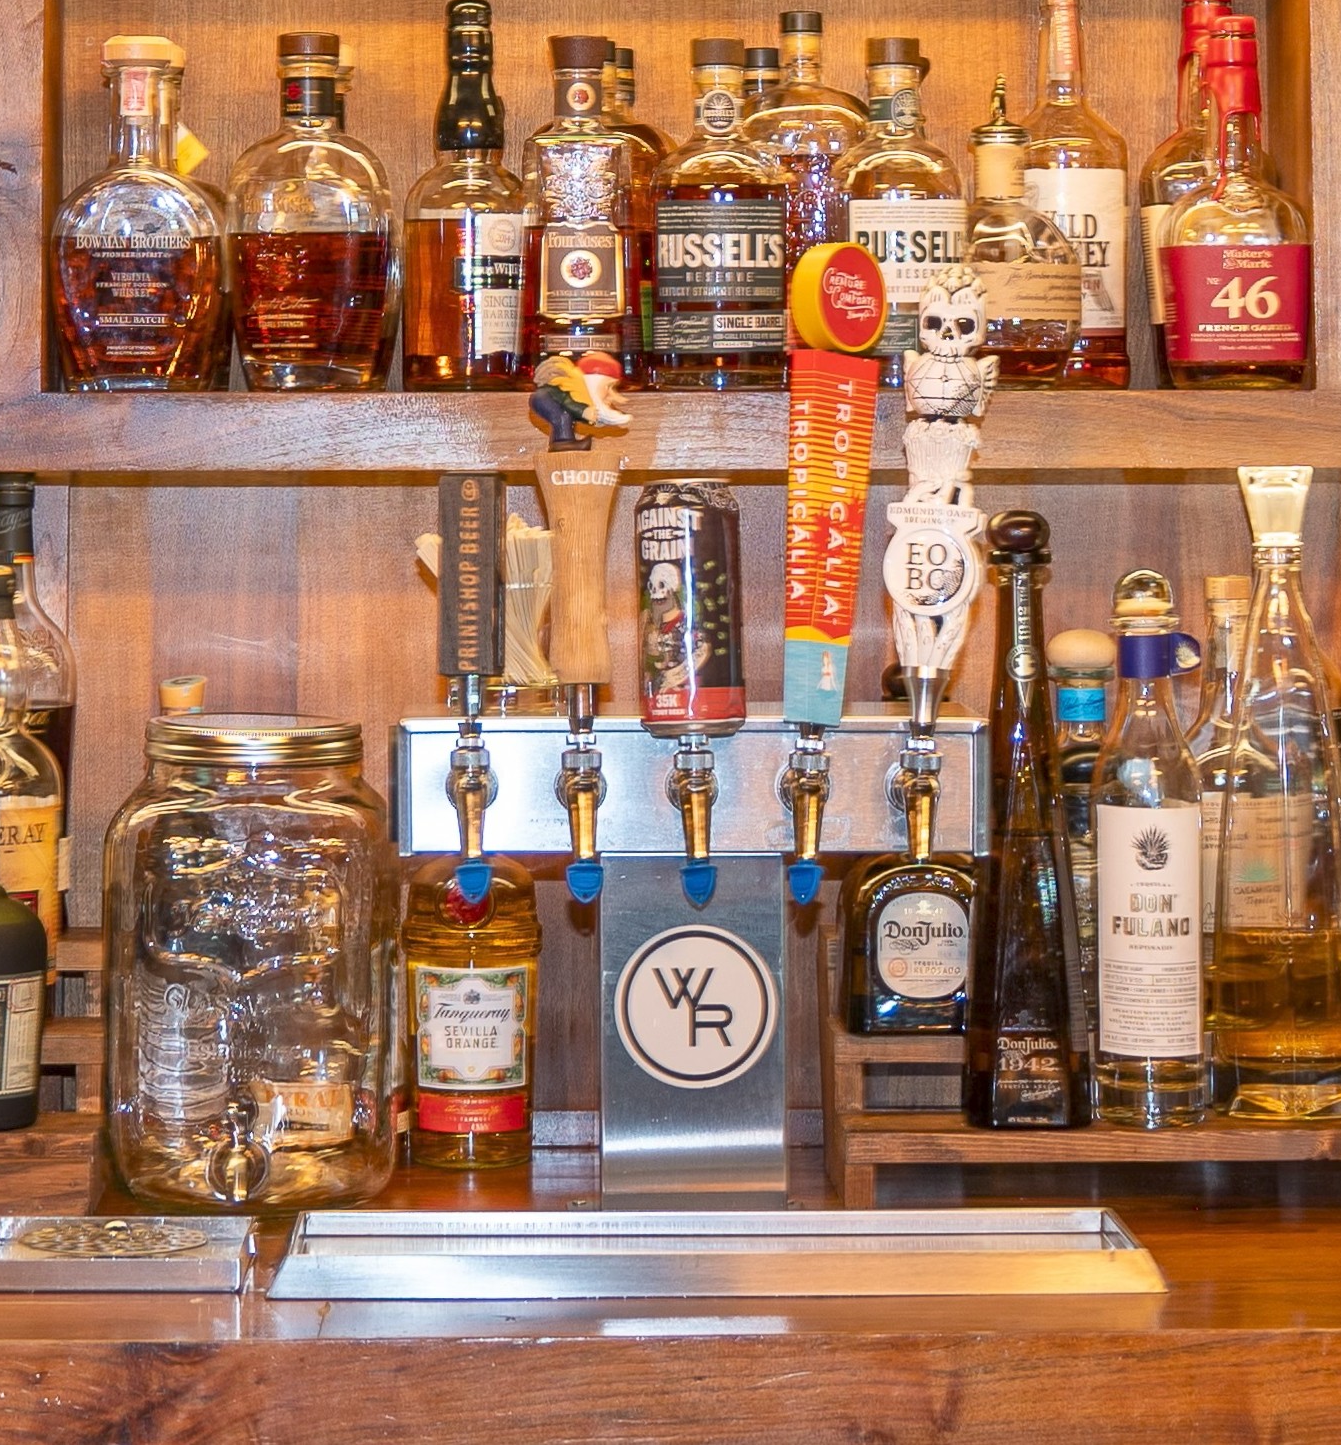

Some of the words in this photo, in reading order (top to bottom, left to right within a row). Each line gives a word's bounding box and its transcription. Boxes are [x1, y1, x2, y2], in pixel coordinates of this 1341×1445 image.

[76, 235, 126, 249] BOWMAN
[130, 235, 191, 249] BROTHERS
[547, 231, 575, 248] Four
[576, 231, 614, 249] Roses
[659, 232, 784, 269] RUSSELL'S
[1223, 249, 1272, 260] Maker's
[1235, 259, 1272, 269] Mark
[111, 272, 151, 282] VIRGINIA
[685, 271, 754, 284] RESERVE
[112, 288, 151, 297] WHISKEY
[1210, 275, 1281, 319] 46
[99, 316, 131, 324] SMALL
[133, 316, 165, 324] BATCH
[716, 315, 753, 329] SINGLE
[754, 315, 784, 329] BARREL
[1198, 324, 1250, 332] FRENCH
[638, 507, 703, 532] AGAINST
[460, 505, 480, 563] BEER
[653, 529, 672, 540] THE
[641, 540, 686, 561] GRAIN
[907, 542, 948, 567] EO
[906, 567, 947, 591] BC
[459, 568, 479, 673] PRINTSHOP
[654, 694, 678, 708] 35K
[1130, 893, 1173, 913] DON
[1112, 916, 1190, 938] FULANO
[433, 1001, 512, 1030] Tanqueray
[444, 1025, 499, 1038] SEVILLA
[444, 1037, 499, 1050] ORANGE
[998, 1057, 1055, 1072] 1942
